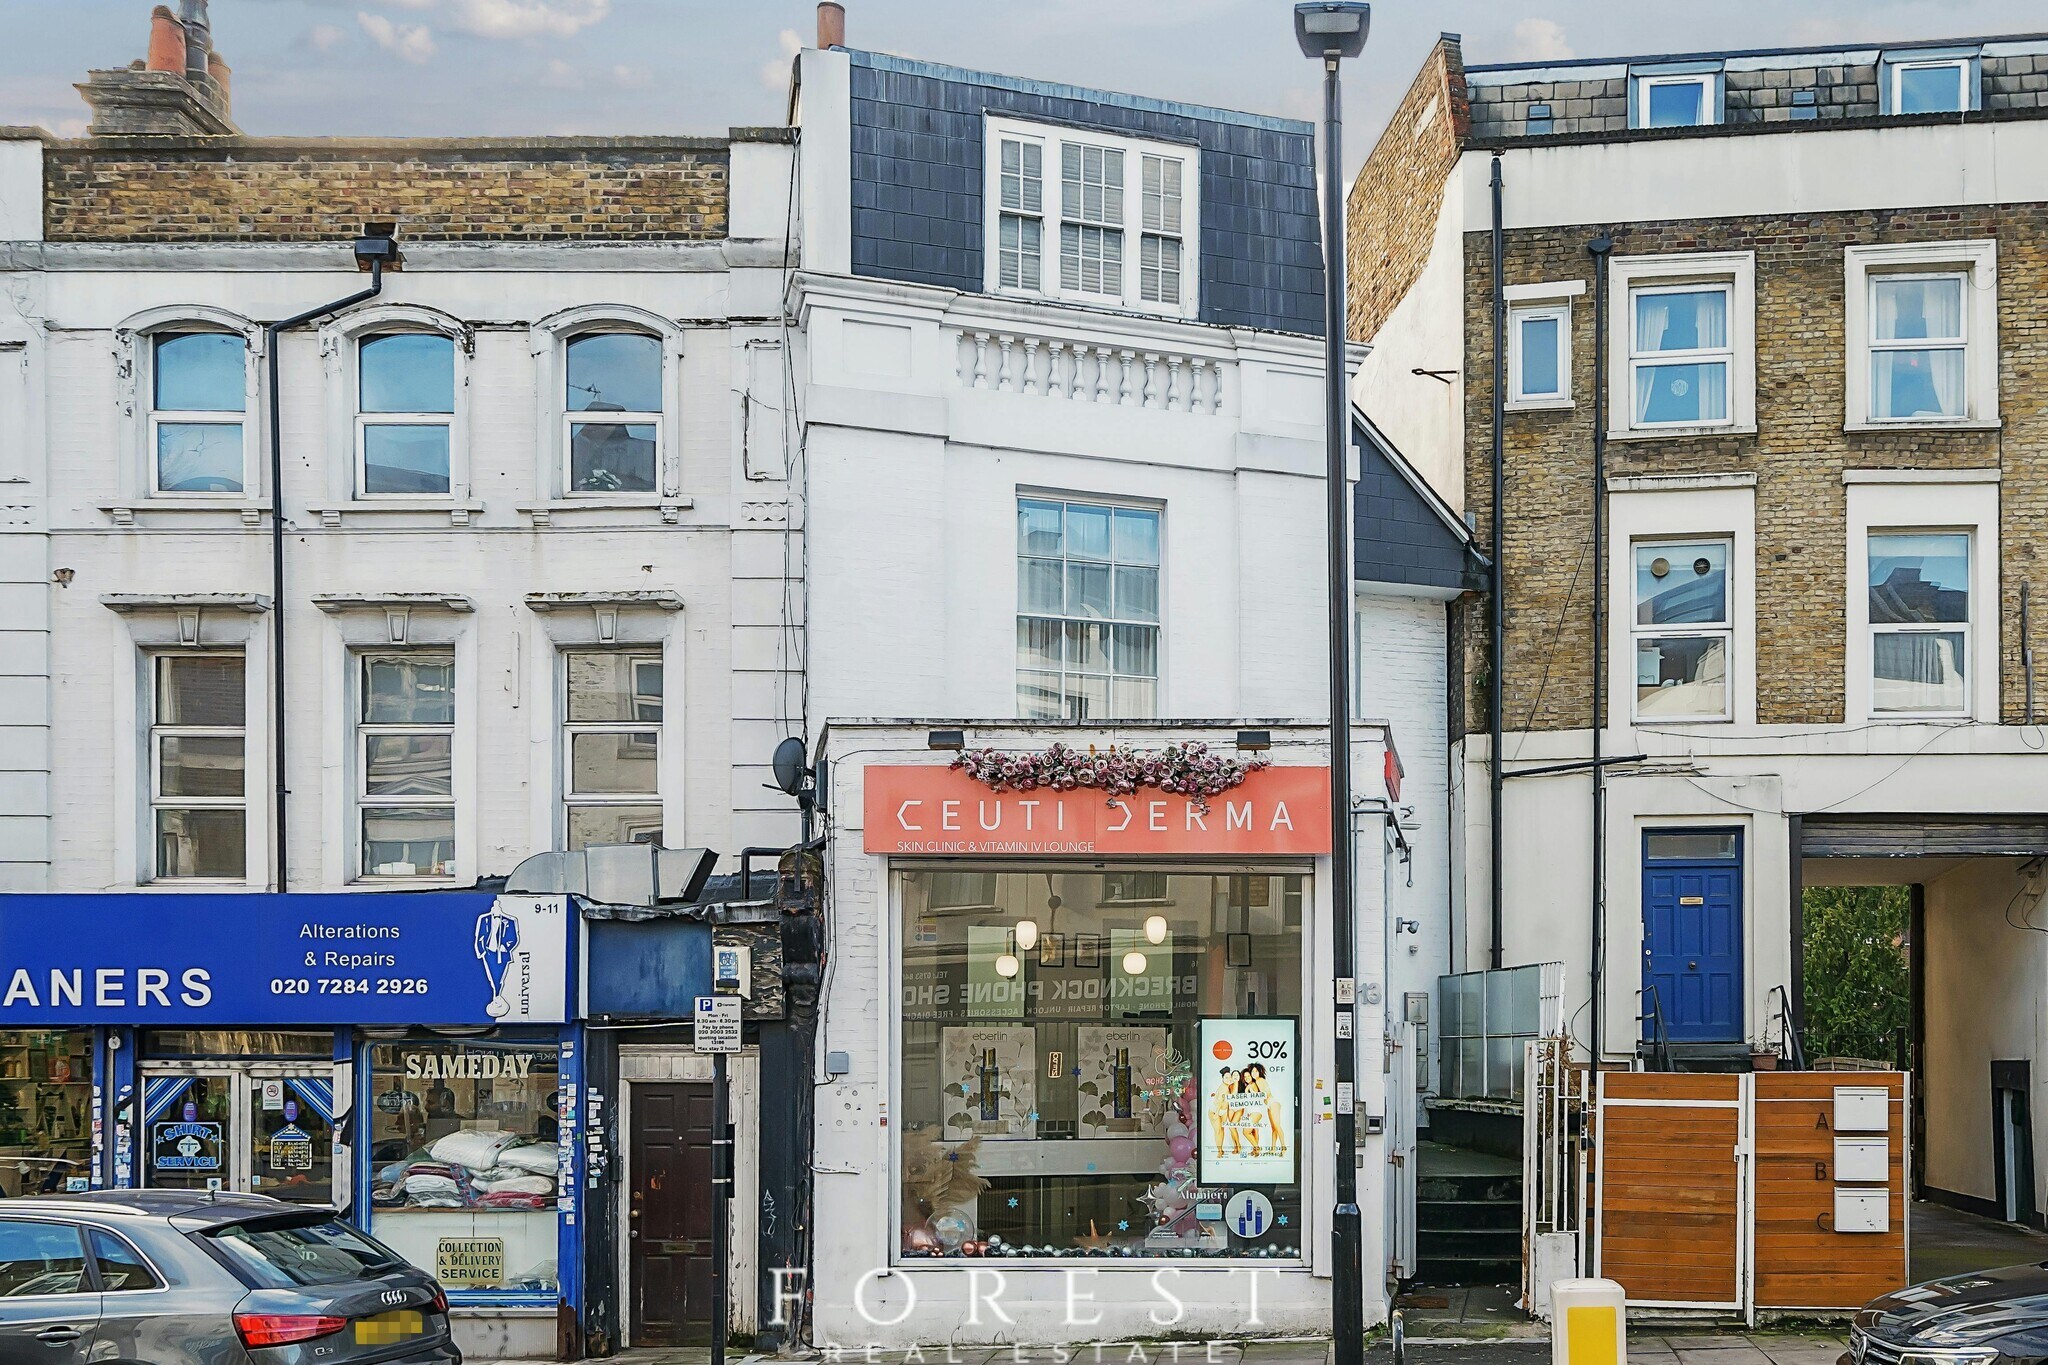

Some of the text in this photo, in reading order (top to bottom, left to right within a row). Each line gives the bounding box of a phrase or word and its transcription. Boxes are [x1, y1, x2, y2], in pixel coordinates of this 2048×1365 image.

[896, 800, 1294, 831] CEUTI DERMA
[897, 841, 1095, 852] SKIN CLINIC & VITAMIN IV LOUNGE
[534, 903, 559, 914] 9-11
[300, 923, 400, 939] Alterations
[304, 951, 396, 969] & Repairs
[2, 968, 212, 1007] ANERS
[270, 978, 428, 994] 020 7284 2926
[519, 951, 531, 1015] universal
[703, 1000, 711, 1010] P
[973, 1031, 1007, 1041] eberlin
[1106, 1031, 1140, 1041] eberlin
[1247, 1041, 1287, 1059] 30%
[406, 1054, 533, 1079] SAMEDAY
[1815, 1112, 1829, 1130] A
[164, 1123, 212, 1140] SHIRT
[158, 1156, 216, 1167] SERVICE
[1815, 1162, 1827, 1181] B
[1816, 1212, 1830, 1231] C
[438, 1242, 501, 1252] COLLECTION
[439, 1255, 501, 1265] & DELIVERY
[441, 1268, 499, 1279] SERVICE
[315, 1347, 333, 1356] Q3
